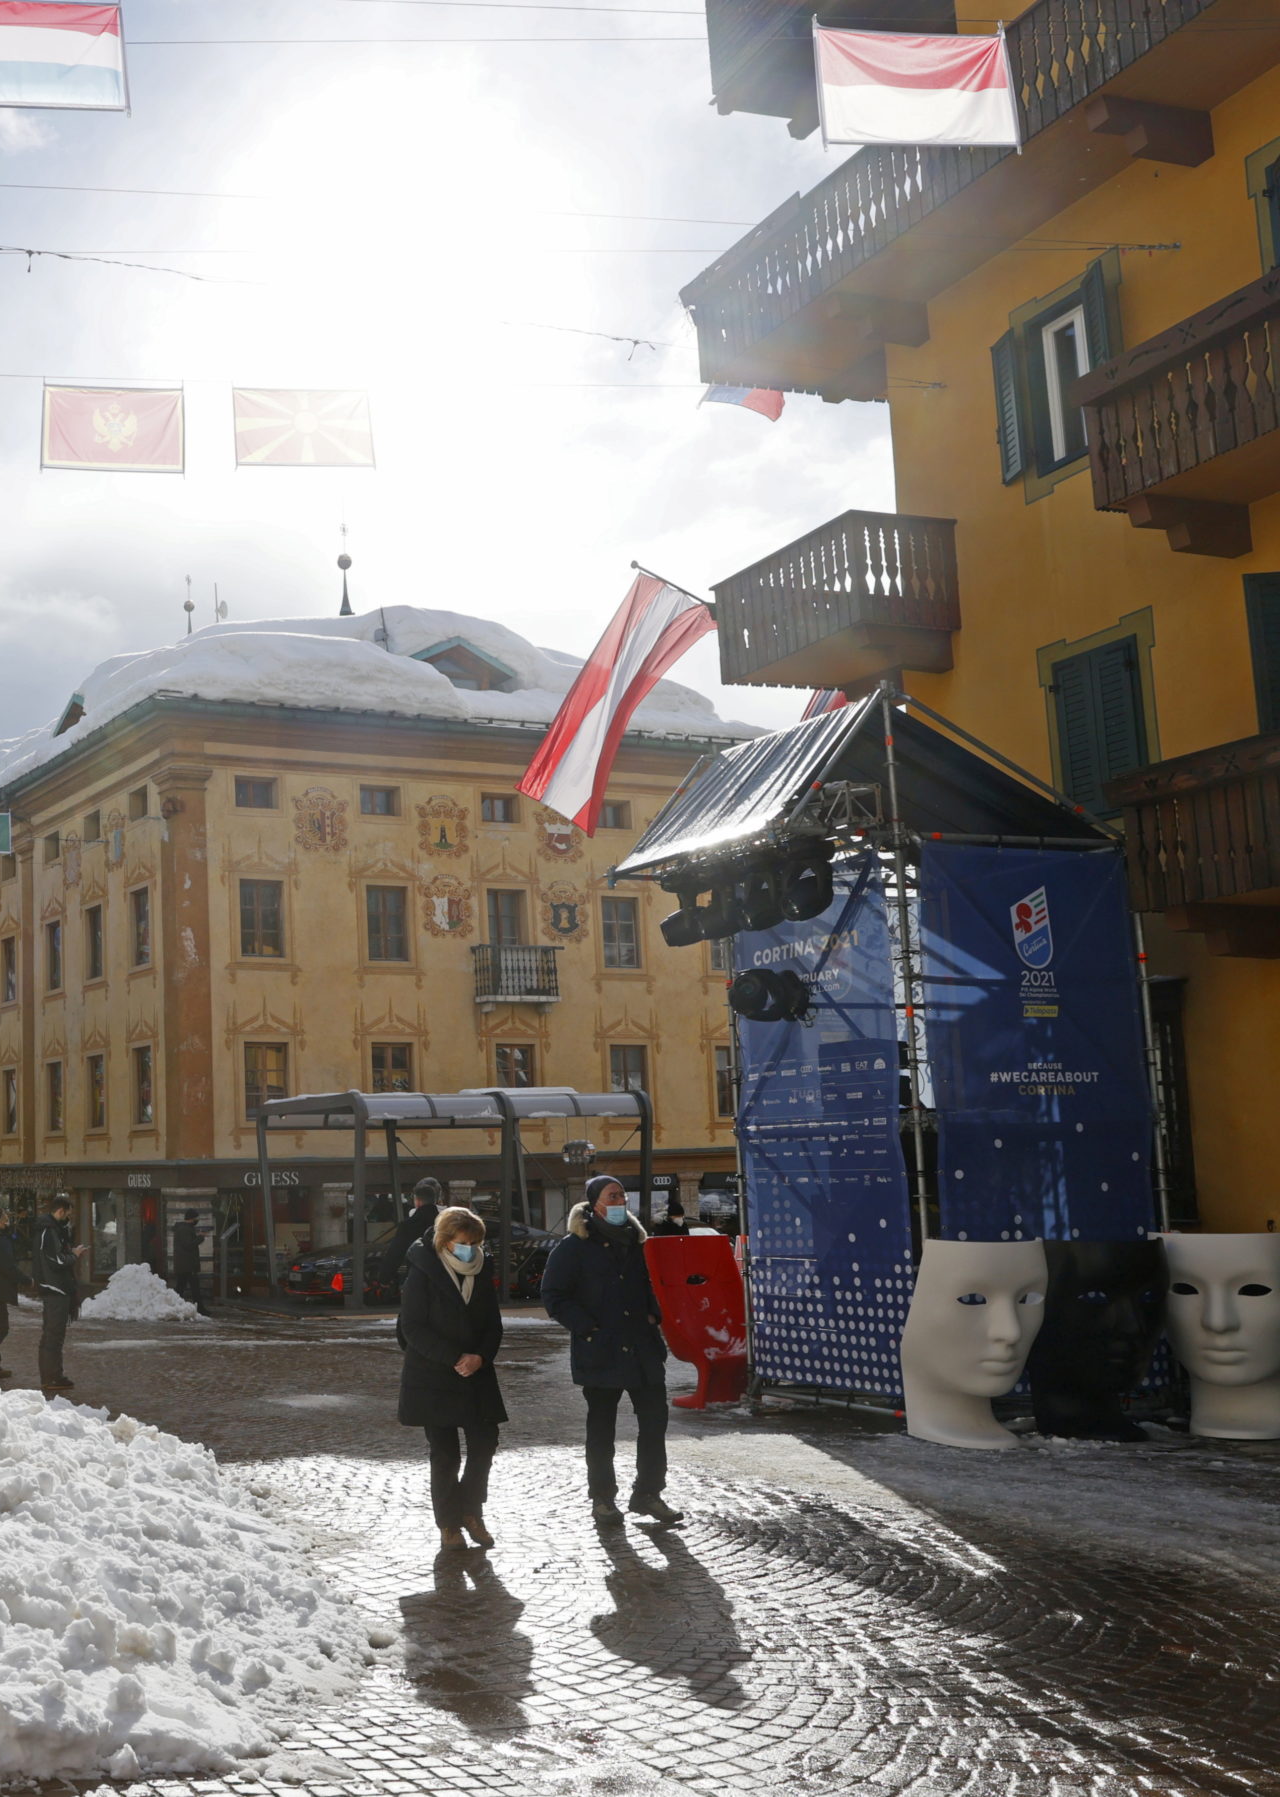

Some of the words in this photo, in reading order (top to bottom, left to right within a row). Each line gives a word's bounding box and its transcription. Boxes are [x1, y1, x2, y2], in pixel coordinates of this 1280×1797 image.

[753, 939, 815, 967] CORTINA
[820, 930, 860, 952] 2021
[1020, 970, 1056, 986] 2021
[1027, 1062, 1063, 1070] BECAUSE
[989, 1071, 1100, 1084] #WECAREABOUT
[1018, 1084, 1076, 1096] CORTINA
[127, 1174, 151, 1188] GUESS
